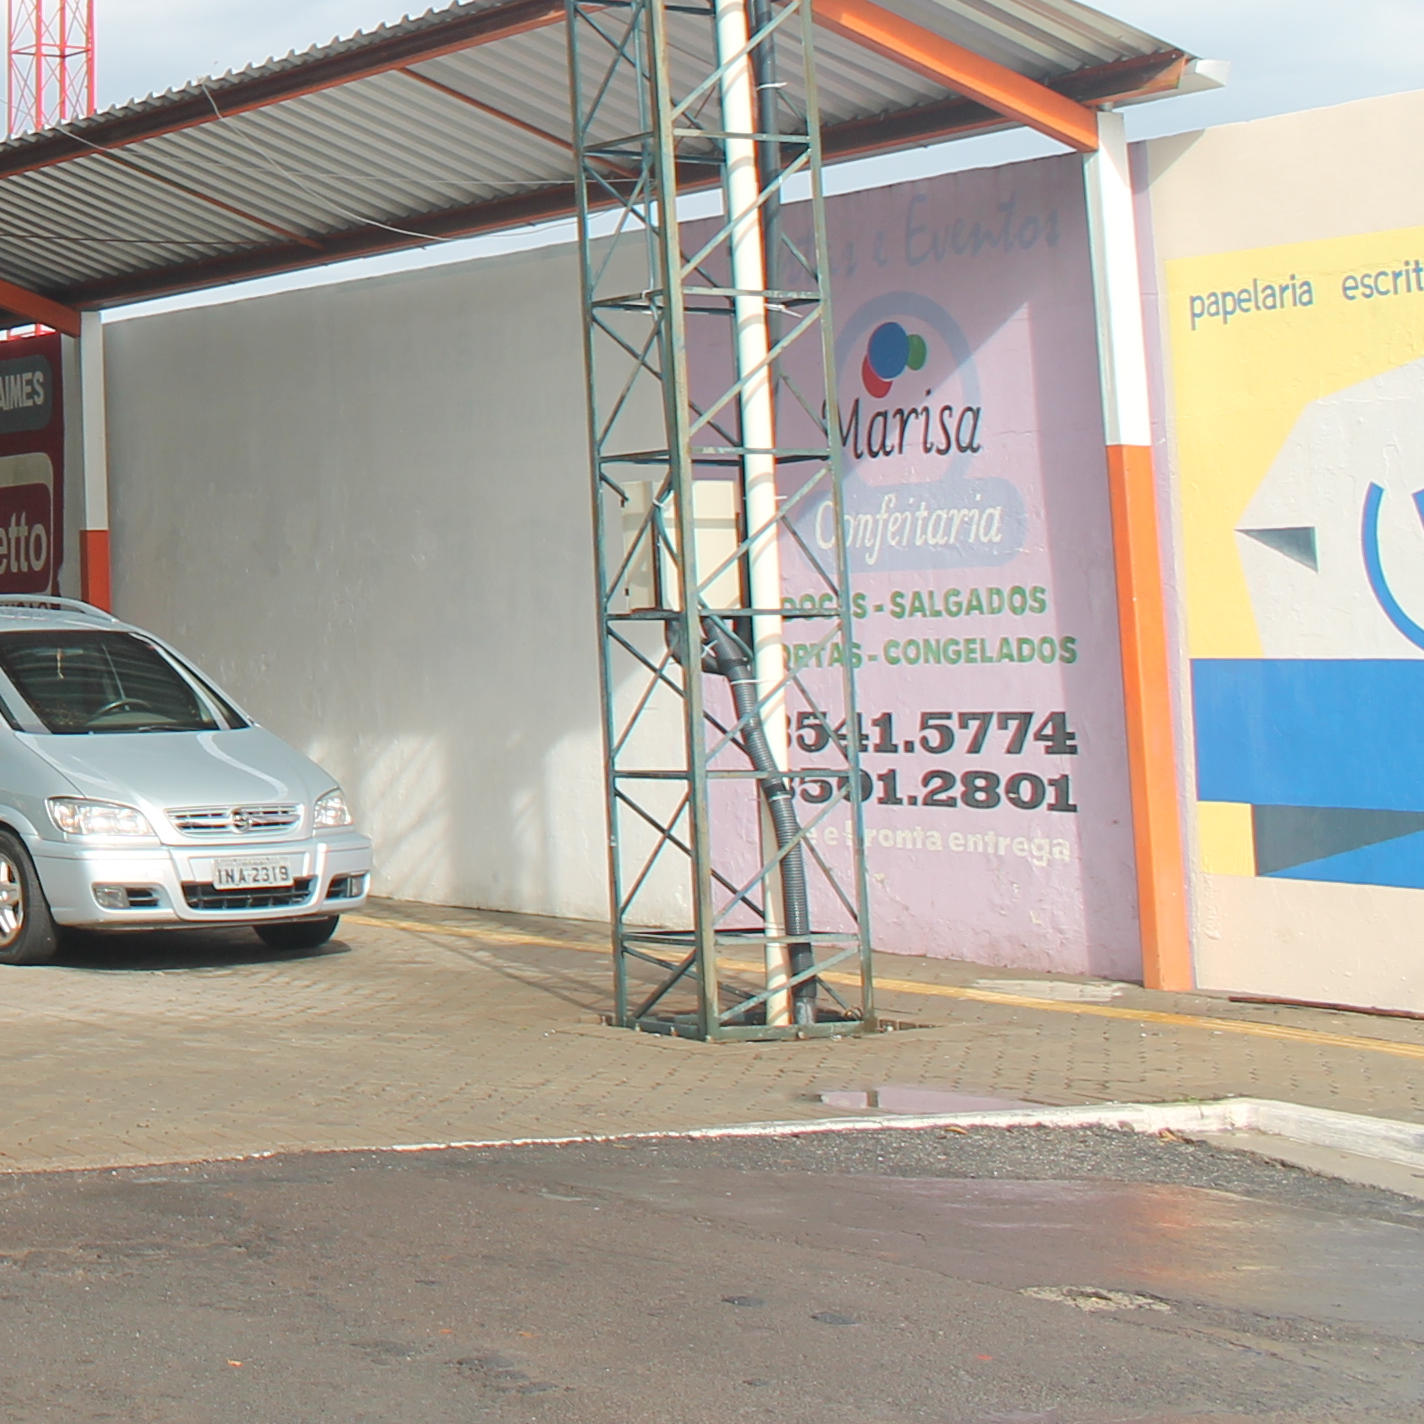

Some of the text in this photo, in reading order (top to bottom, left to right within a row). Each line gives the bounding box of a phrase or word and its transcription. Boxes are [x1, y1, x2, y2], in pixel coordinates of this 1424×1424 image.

[906, 190, 1062, 268] Eventos
[1189, 273, 1314, 331] papelaria
[821, 388, 982, 460] Marisa
[814, 493, 1003, 565] Confeitaria
[781, 592, 868, 622] DOCS
[889, 585, 1048, 620] SALGADOS
[882, 635, 1079, 665] CONGELADOS
[947, 827, 1071, 867] entrega
